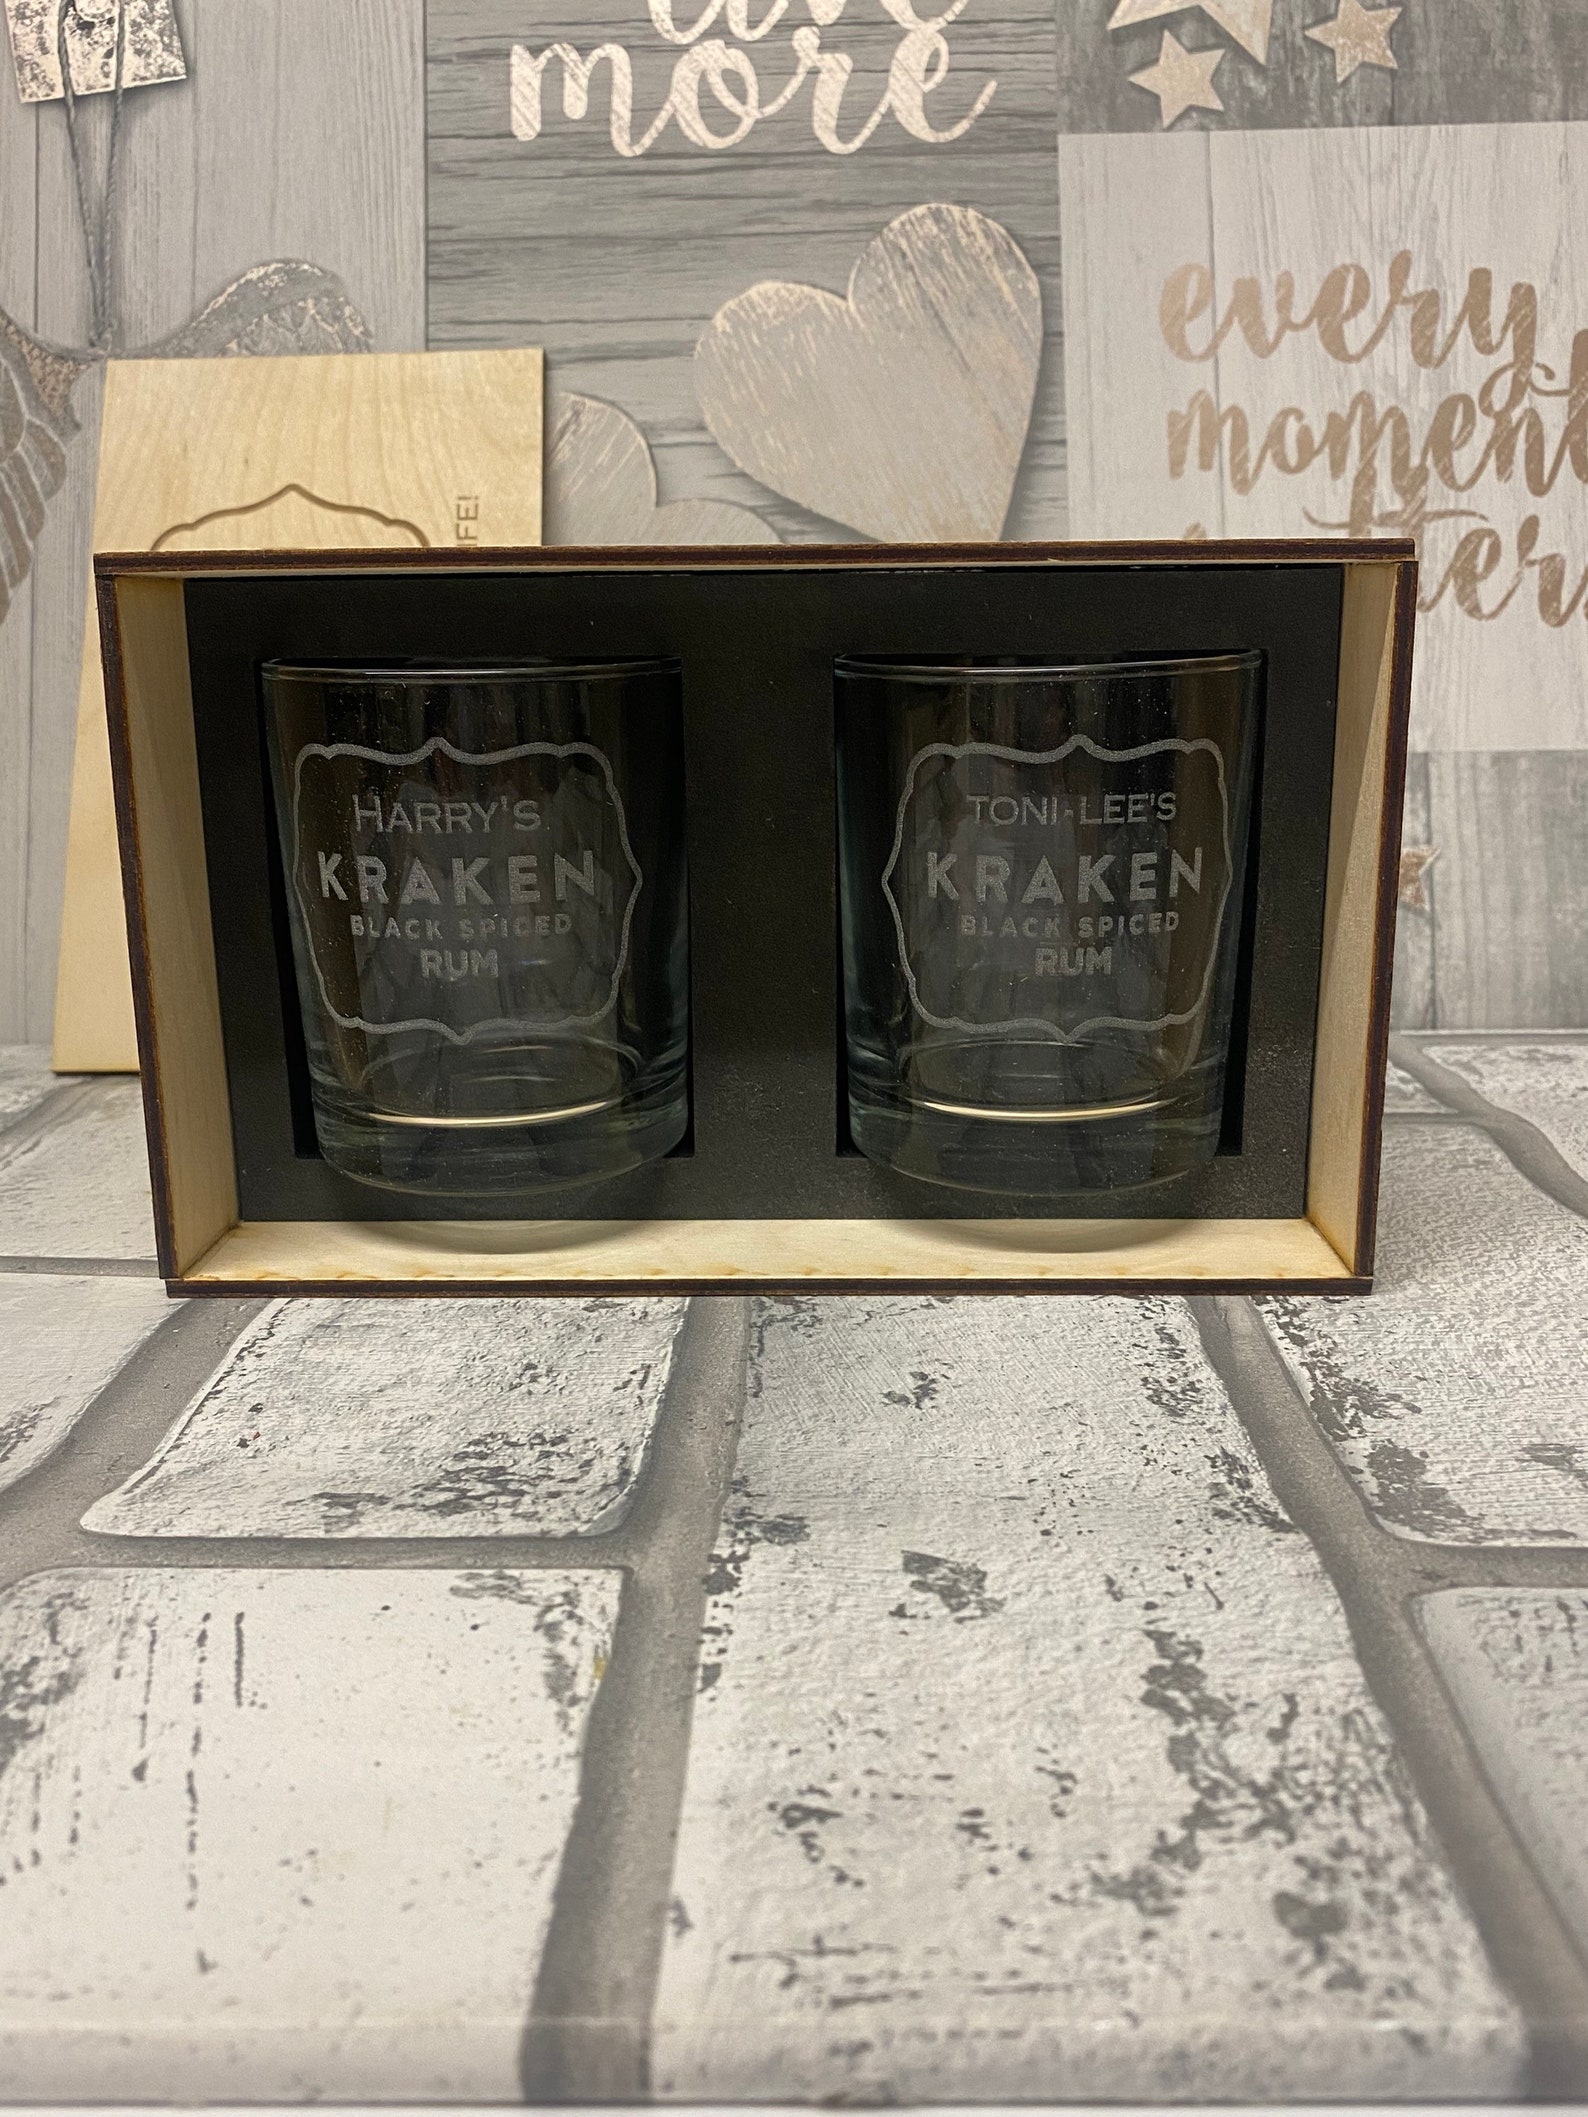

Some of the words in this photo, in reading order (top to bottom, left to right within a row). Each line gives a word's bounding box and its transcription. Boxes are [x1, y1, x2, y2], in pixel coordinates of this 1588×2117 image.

[509, 26, 998, 157] more
[1159, 249, 1556, 415] every
[351, 793, 543, 836] HARRY'S
[965, 791, 1178, 828] TONI-LEE'S
[317, 849, 597, 907] KRAKEN
[926, 847, 1204, 905] KRAKEN
[350, 914, 443, 941] BLACK
[457, 912, 574, 941] SPICED
[959, 914, 1062, 939] BLACK
[1077, 910, 1181, 939] SPICED
[420, 948, 500, 981] RUM
[1034, 945, 1114, 978] RUM
